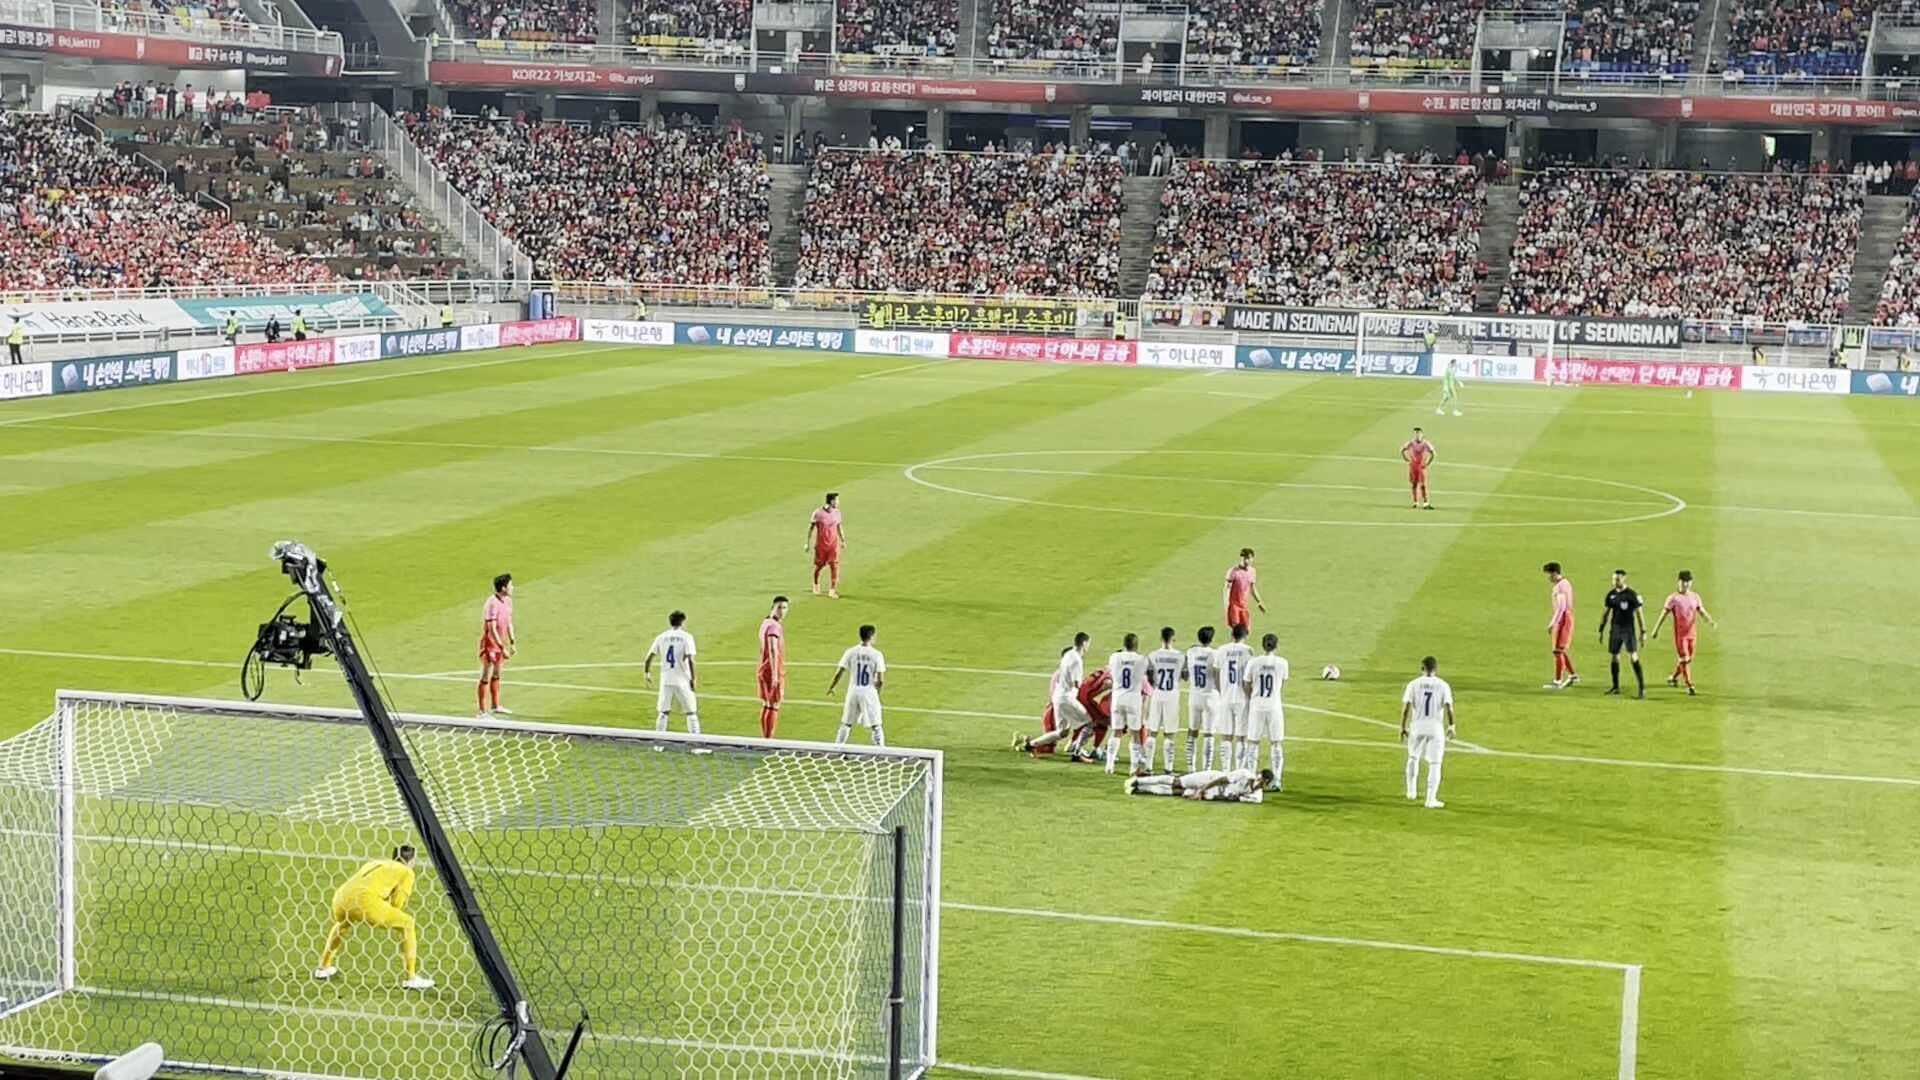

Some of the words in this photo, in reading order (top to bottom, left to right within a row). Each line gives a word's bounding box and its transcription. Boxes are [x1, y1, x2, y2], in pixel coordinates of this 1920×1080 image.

[512, 69, 552, 81] KOR22
[814, 79, 835, 92] 붉은
[837, 79, 868, 94] 심장이
[1185, 90, 1226, 104] 대한민국
[1770, 103, 1816, 116] 대한민국
[1233, 310, 1270, 330] MADE
[1273, 311, 1288, 331] IN
[1456, 320, 1486, 337] THE
[1559, 322, 1581, 341] OF
[1585, 322, 1679, 344] SEONGNAM
[716, 327, 731, 345] 내
[733, 328, 772, 346] 손안의
[775, 330, 815, 348] 스마트
[817, 331, 844, 350] 뱅킹
[1045, 342, 1057, 360] 단
[1169, 347, 1223, 366] 하나은행
[83, 363, 95, 387] 내
[95, 359, 123, 387] 손안의
[124, 360, 152, 382] 스마트
[1281, 351, 1296, 370] 내
[1298, 352, 1341, 372] 손안의
[1390, 355, 1419, 375] 뱅킹
[1639, 363, 1654, 384] 단
[1656, 365, 1699, 386] 하나의
[4, 368, 44, 394] 하나은행
[1777, 370, 1837, 390] 하나은행
[1901, 375, 1920, 395] 내
[666, 645, 676, 668] 4
[857, 662, 870, 686] 16
[1122, 668, 1131, 689] 8
[1158, 668, 1174, 691] 23
[1194, 664, 1206, 688] 15
[1228, 660, 1237, 684] 5
[1260, 674, 1273, 697] 19
[1424, 692, 1432, 716] 7
